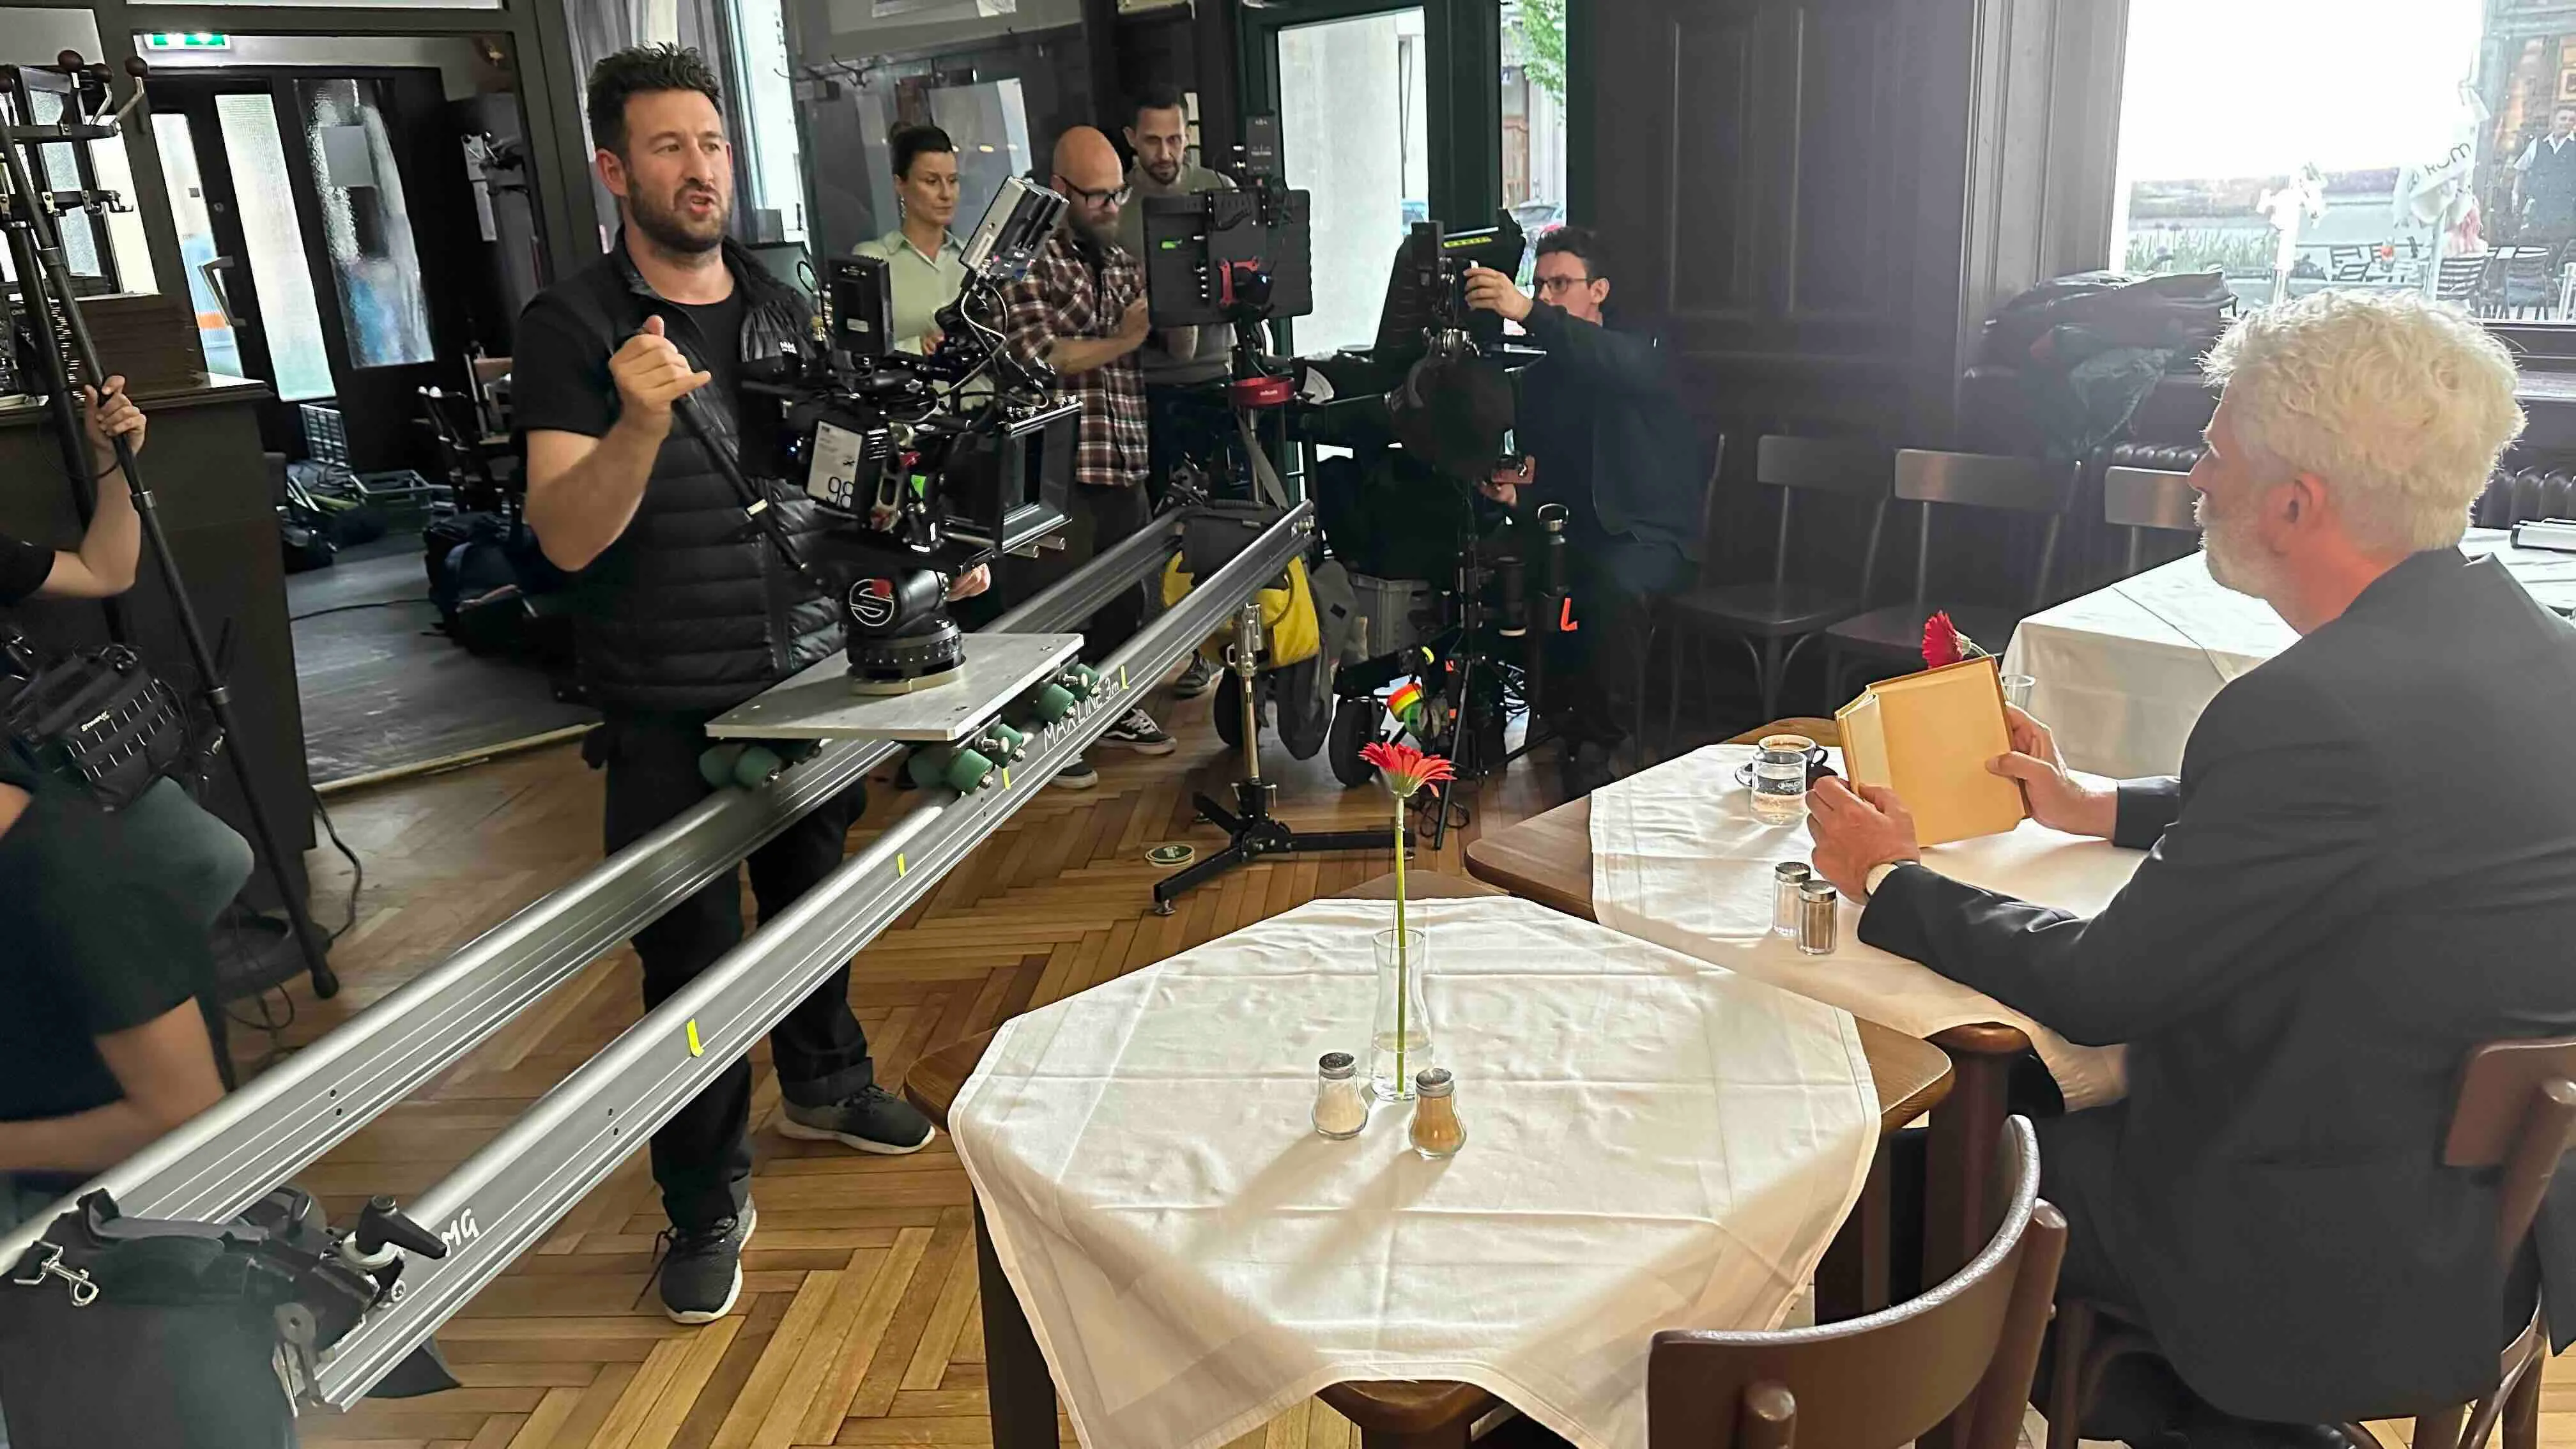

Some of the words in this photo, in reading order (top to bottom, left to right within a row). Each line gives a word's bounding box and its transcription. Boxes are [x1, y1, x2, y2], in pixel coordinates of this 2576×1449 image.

[827, 476, 854, 508] 98
[1105, 677, 1119, 700] 3m
[441, 1208, 480, 1257] MG
